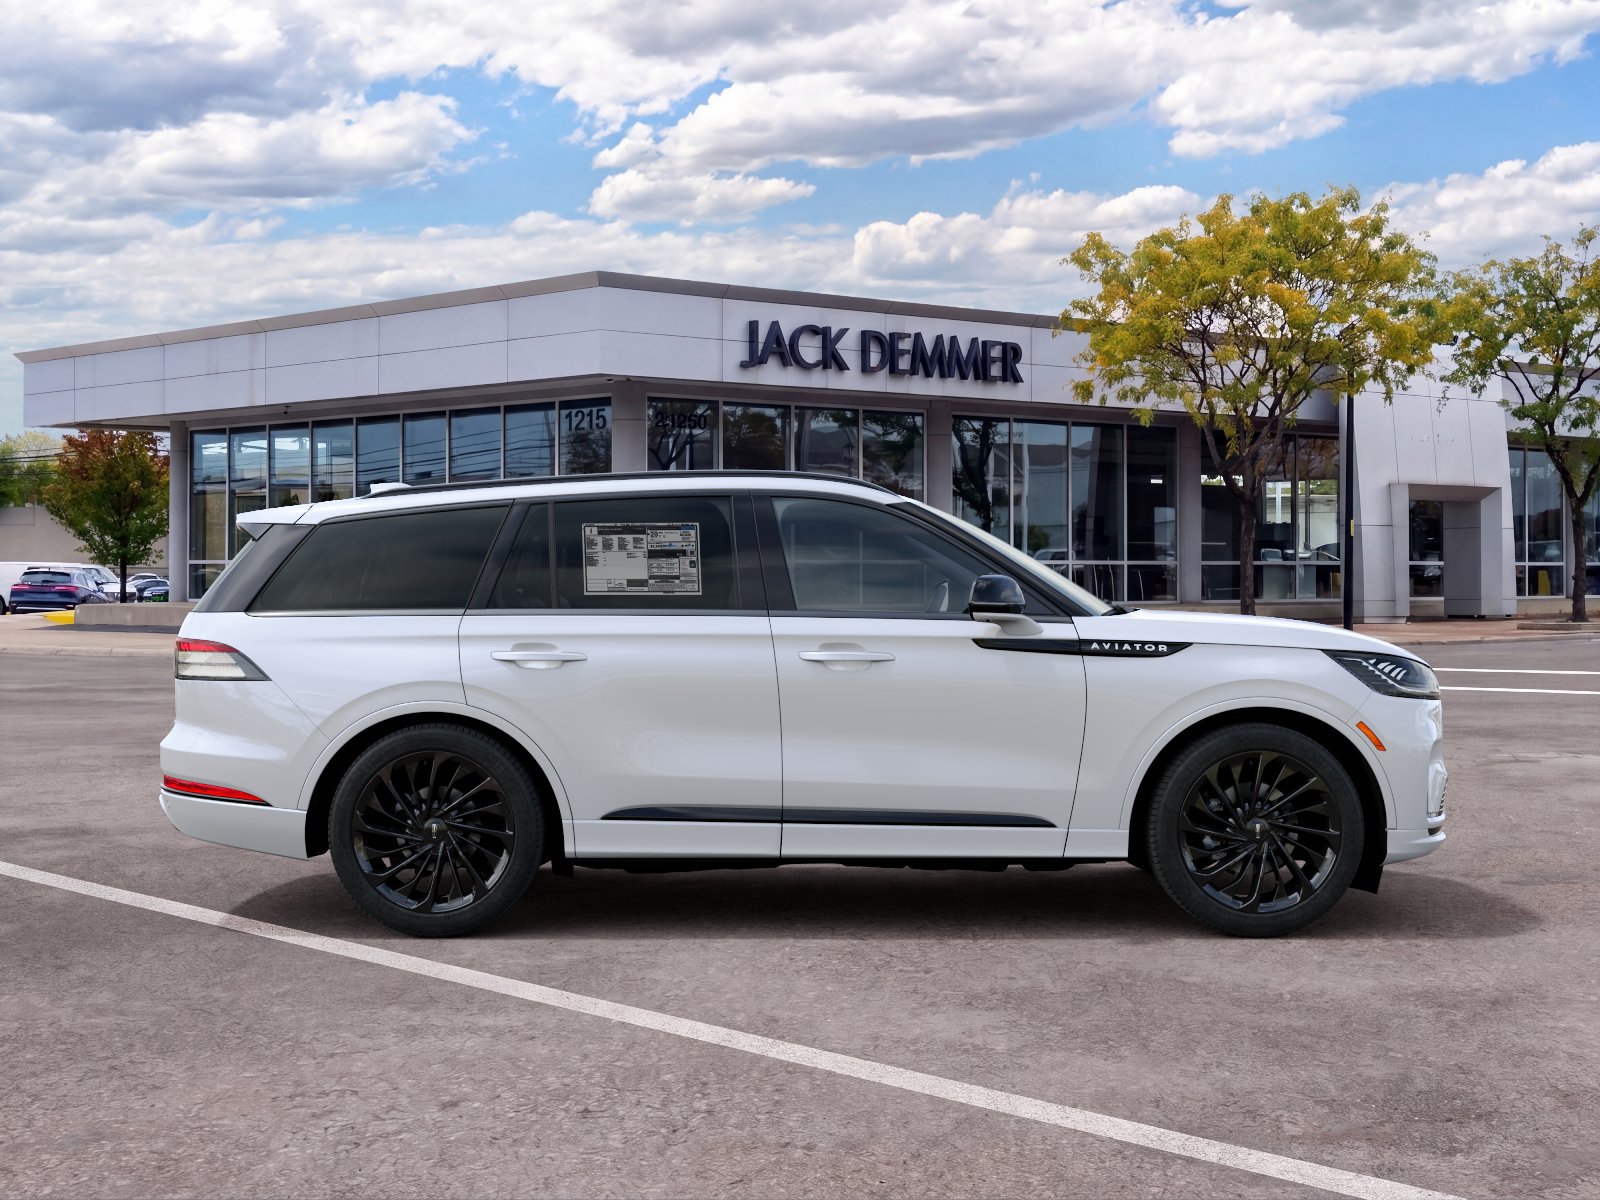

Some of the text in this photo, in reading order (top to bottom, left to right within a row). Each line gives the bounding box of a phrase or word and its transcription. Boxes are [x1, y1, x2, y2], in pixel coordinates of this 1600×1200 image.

[740, 320, 1024, 383] JACK DEMMER
[565, 408, 607, 432] 1215
[1090, 642, 1168, 652] AVIATOR
